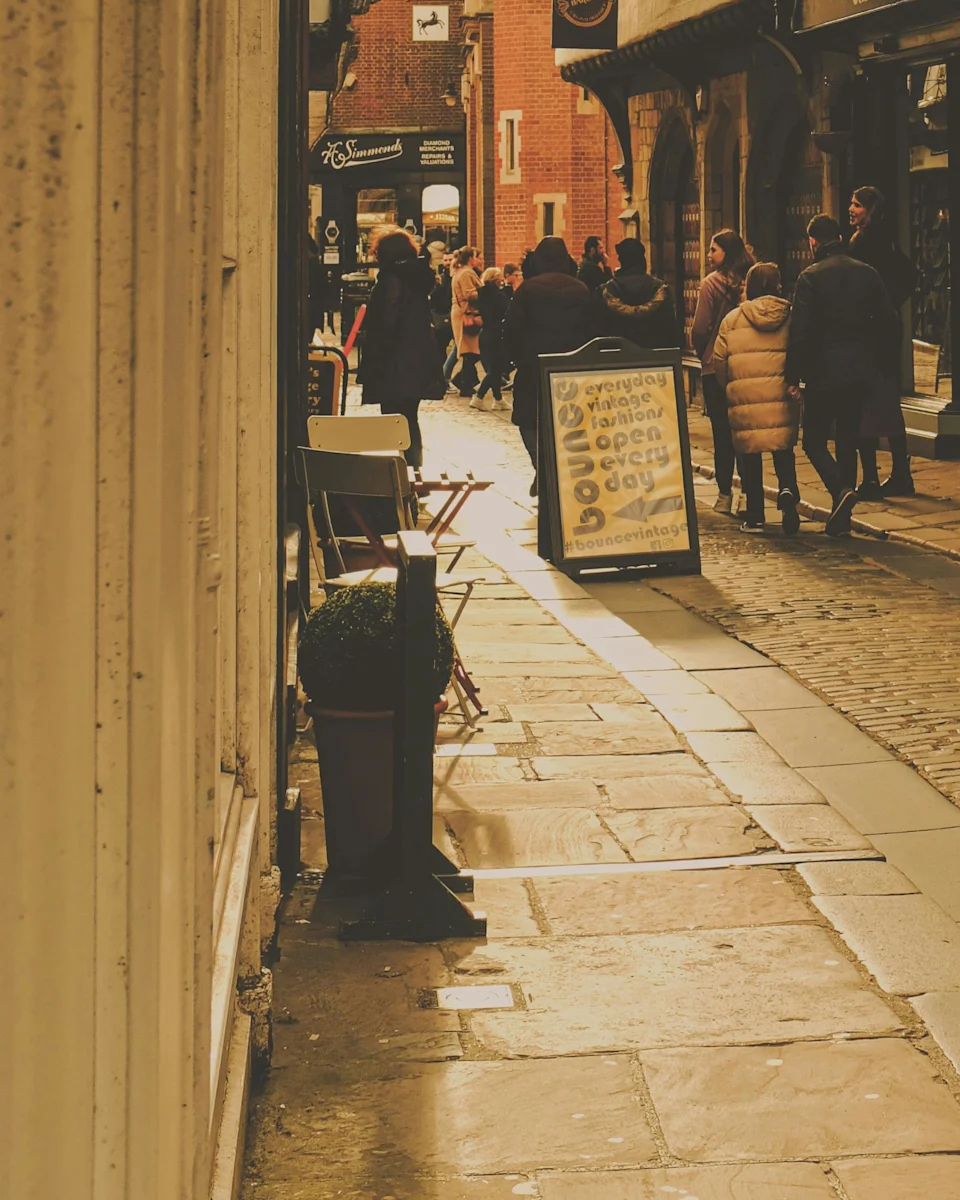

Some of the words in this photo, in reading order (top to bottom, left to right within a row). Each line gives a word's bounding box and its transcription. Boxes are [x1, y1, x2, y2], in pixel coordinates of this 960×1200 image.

[338, 138, 403, 162] Simmonds
[585, 372, 667, 396] everyday
[586, 392, 652, 413] vintage
[591, 406, 664, 430] fashions
[595, 425, 662, 454] open
[600, 445, 670, 472] every
[604, 470, 655, 493] day
[564, 522, 689, 553] #bouncevintage
